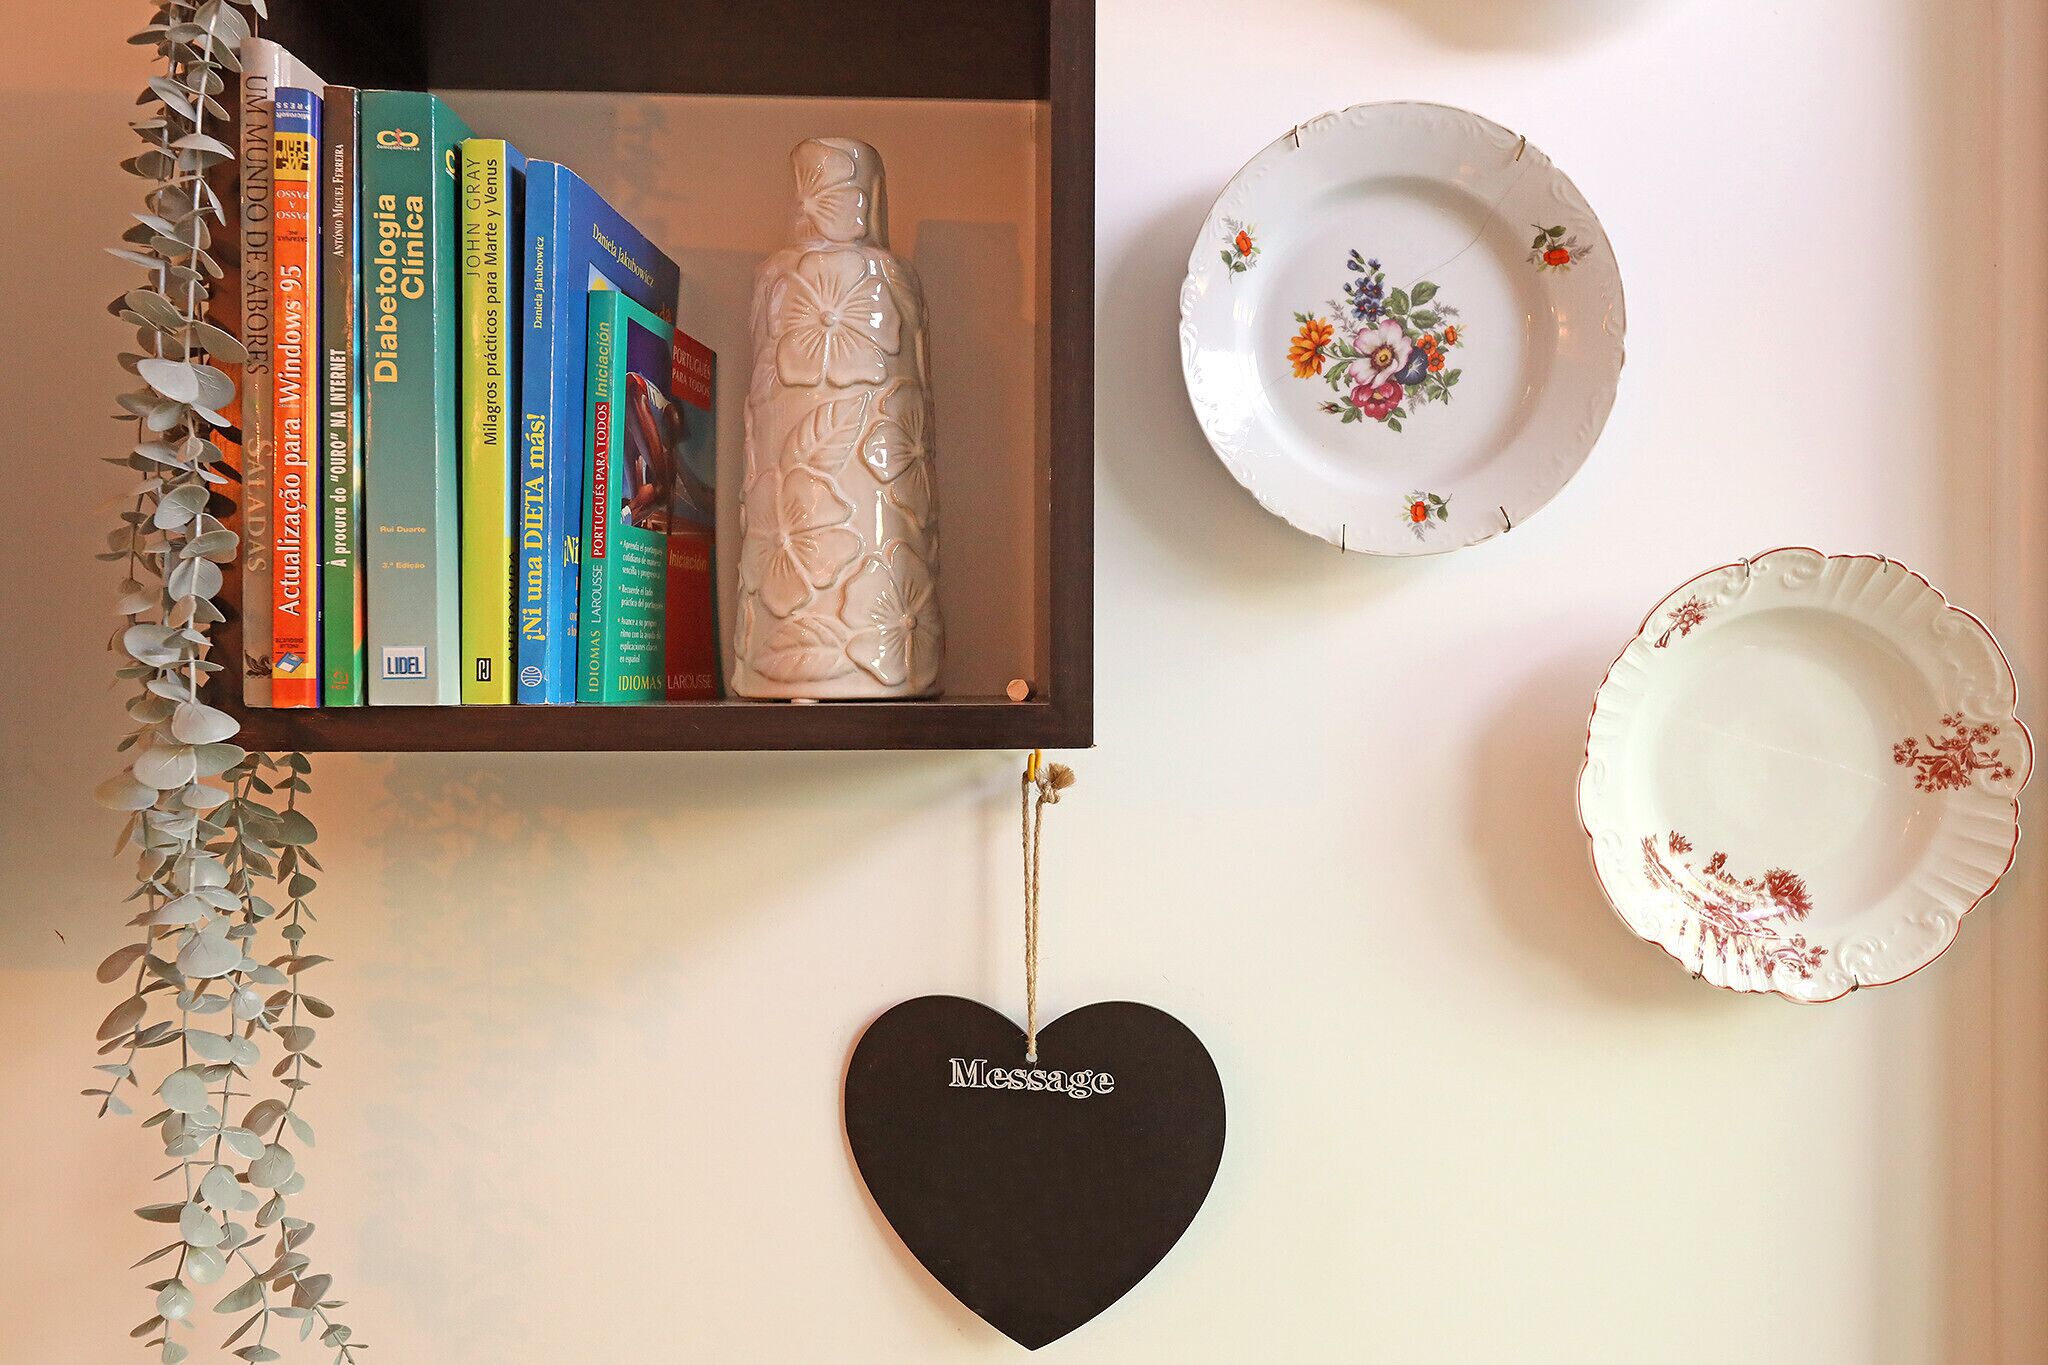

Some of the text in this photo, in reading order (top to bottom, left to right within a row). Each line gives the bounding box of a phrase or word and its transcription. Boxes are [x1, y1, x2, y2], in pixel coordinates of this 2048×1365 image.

[246, 76, 269, 374] UM MUNDO DE SABORES
[276, 190, 310, 199] PASSO
[276, 211, 310, 220] PASSO
[289, 201, 295, 209] A
[332, 144, 344, 257] ANTÓNIO MIGUEL FERREIRA
[467, 158, 480, 277] JOHN GRAY
[280, 264, 302, 292] 95
[400, 196, 425, 300] Clínica
[592, 223, 655, 289] Daniela Jakubowicz
[373, 194, 402, 383] Diabetologia
[483, 158, 501, 445] Milagros prácticos para Marte y Venus
[533, 236, 545, 329] Daniela Jakubowicz
[277, 299, 302, 405] Windows
[330, 349, 347, 406] INTERNET
[595, 321, 610, 398] Iniciación
[284, 417, 309, 466] para
[330, 411, 346, 427] NA
[247, 438, 273, 572] SALADAS
[330, 487, 347, 503] do
[593, 404, 607, 556] PORTUGUÉS PARA TODOS
[277, 473, 308, 617] Actualização
[334, 507, 351, 554] procura
[379, 525, 427, 533] Rui Duarte
[521, 413, 547, 642] ¡Ni una DIETA más!
[396, 562, 426, 570] Edição
[589, 565, 603, 692] IDIOMAS LAROUSSE
[387, 656, 422, 675] LIDEL
[618, 674, 713, 691] IDIOMAS LAROUSSE
[949, 1057, 1115, 1099] Message
